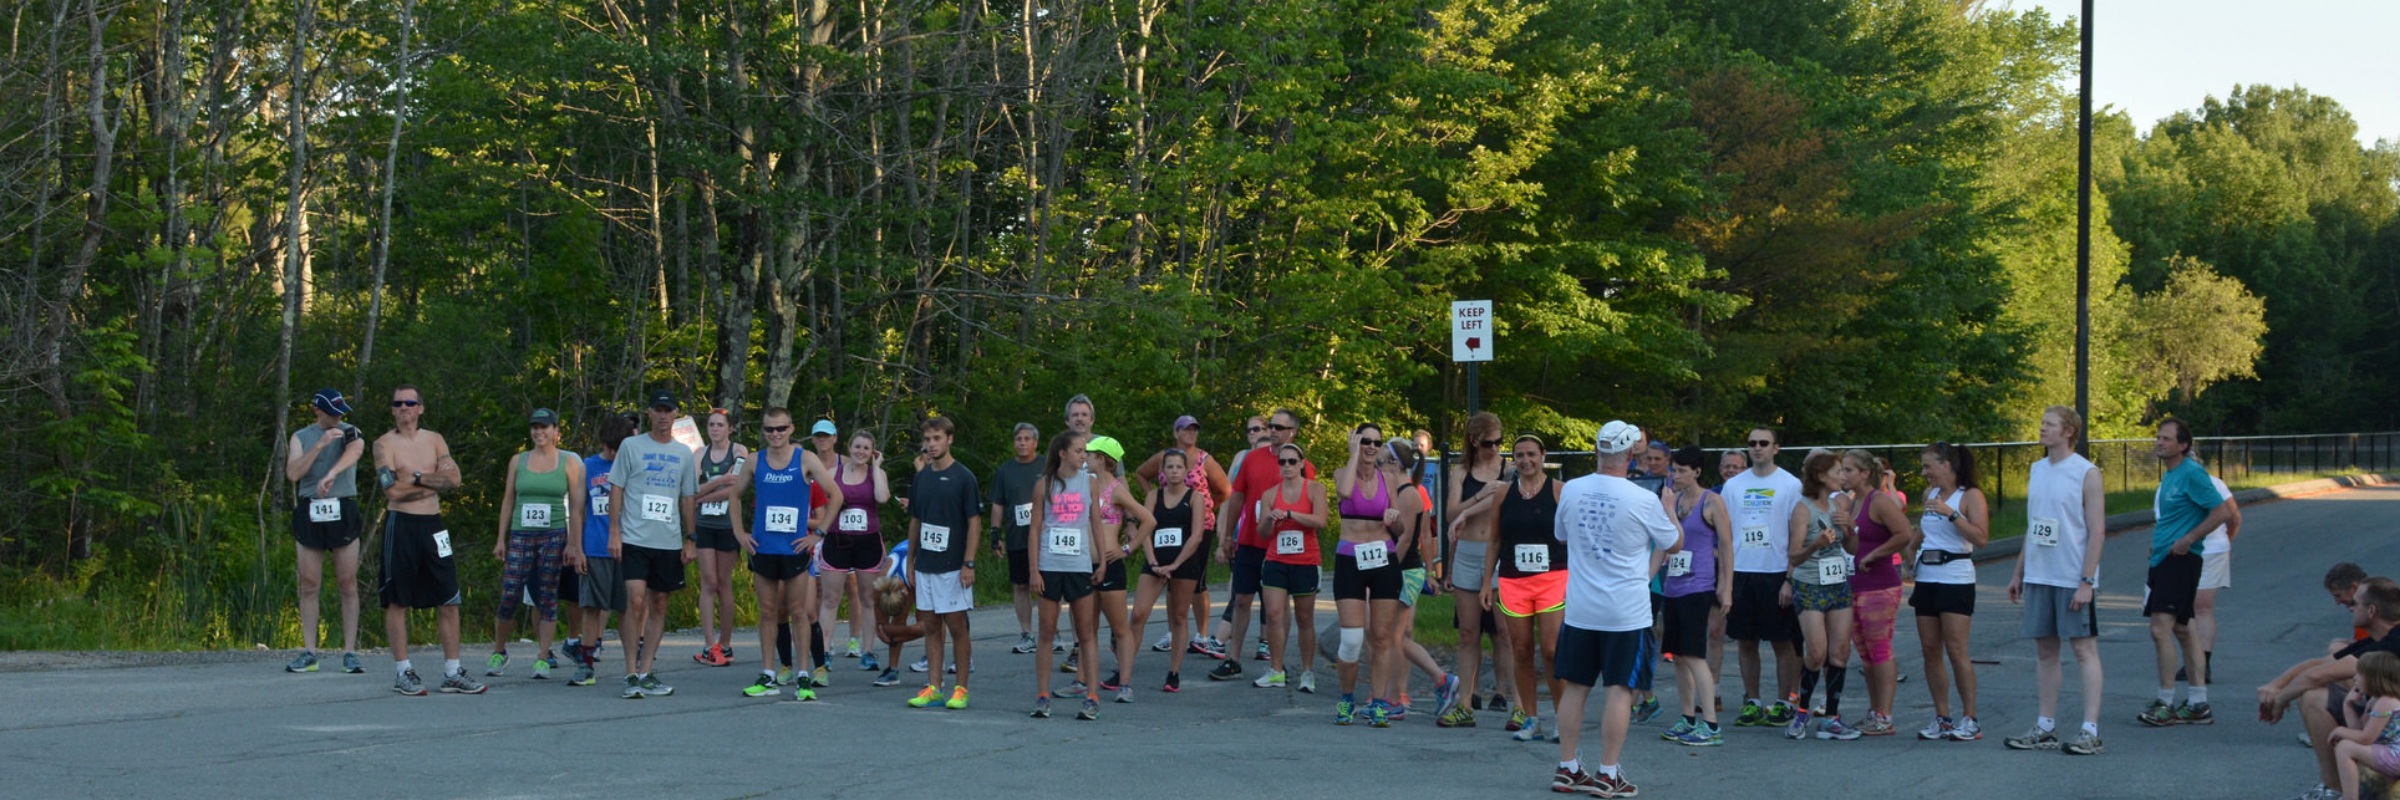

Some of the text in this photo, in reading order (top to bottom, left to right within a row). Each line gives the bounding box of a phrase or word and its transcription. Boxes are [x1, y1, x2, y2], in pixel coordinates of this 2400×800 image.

[1458, 307, 1485, 317] KEEP
[1461, 320, 1483, 330] LEFT
[315, 504, 333, 514] 141
[526, 509, 545, 519] 123
[648, 502, 667, 514] 127
[1019, 509, 1031, 519] 10
[771, 513, 791, 525] 134
[845, 514, 862, 524] 103
[1745, 530, 1763, 542] 119
[2033, 524, 2051, 537] 129
[924, 531, 942, 544] 145
[1055, 535, 1075, 547] 148
[1159, 534, 1176, 545] 139
[1281, 536, 1298, 547] 126
[1362, 548, 1382, 561] 117
[1521, 551, 1543, 563] 116
[1825, 564, 1842, 576] 121
